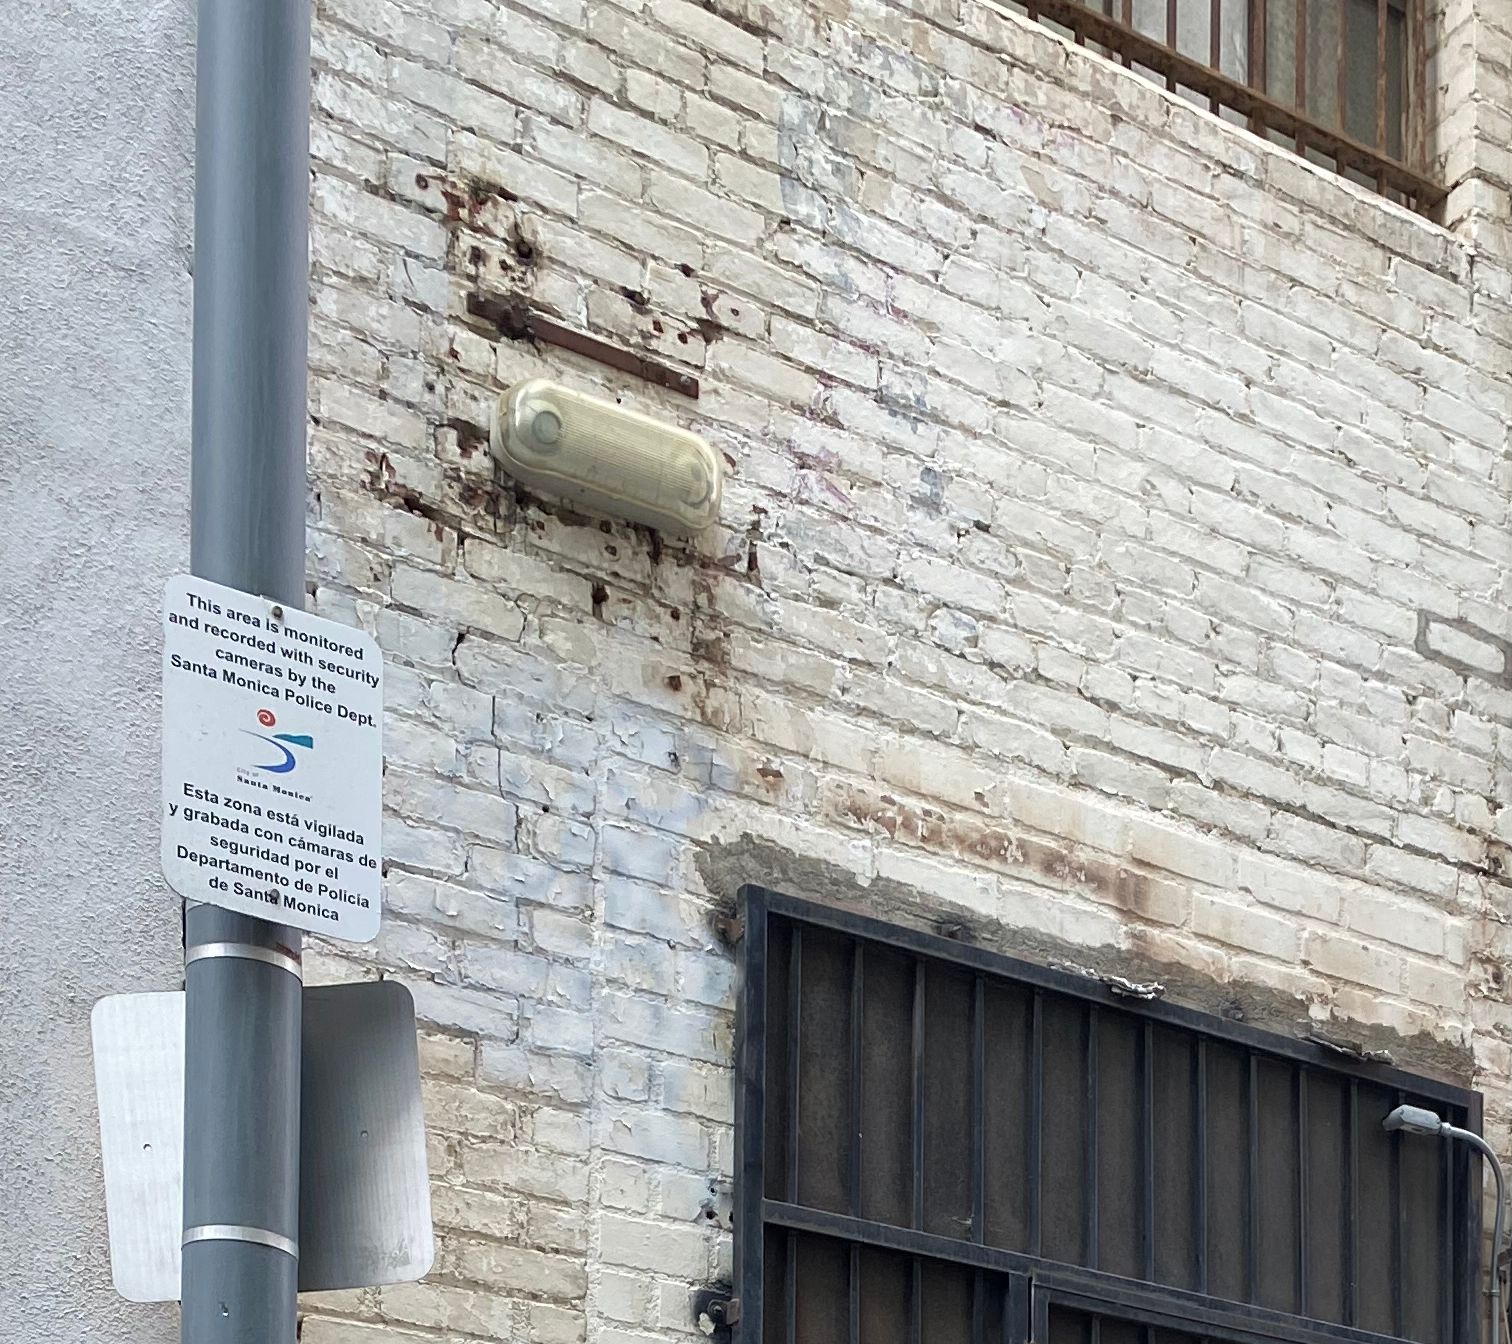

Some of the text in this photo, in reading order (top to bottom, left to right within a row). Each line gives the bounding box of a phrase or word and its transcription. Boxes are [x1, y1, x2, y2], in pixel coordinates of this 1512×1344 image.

[168, 612, 380, 689] and recorded with security
[186, 592, 363, 660] This area is monitored
[170, 653, 377, 728] Santa Monica Police Dept.
[215, 648, 336, 694] cameras by the
[183, 782, 364, 846] Esta zona está vigilada
[236, 775, 312, 802] Santa Monica
[168, 802, 377, 869] y grabada con cámaras de
[210, 835, 339, 880] seguridad por el
[176, 844, 290, 887] Departamento
[294, 877, 313, 894] de
[208, 876, 228, 891] de
[283, 894, 340, 922] Monica
